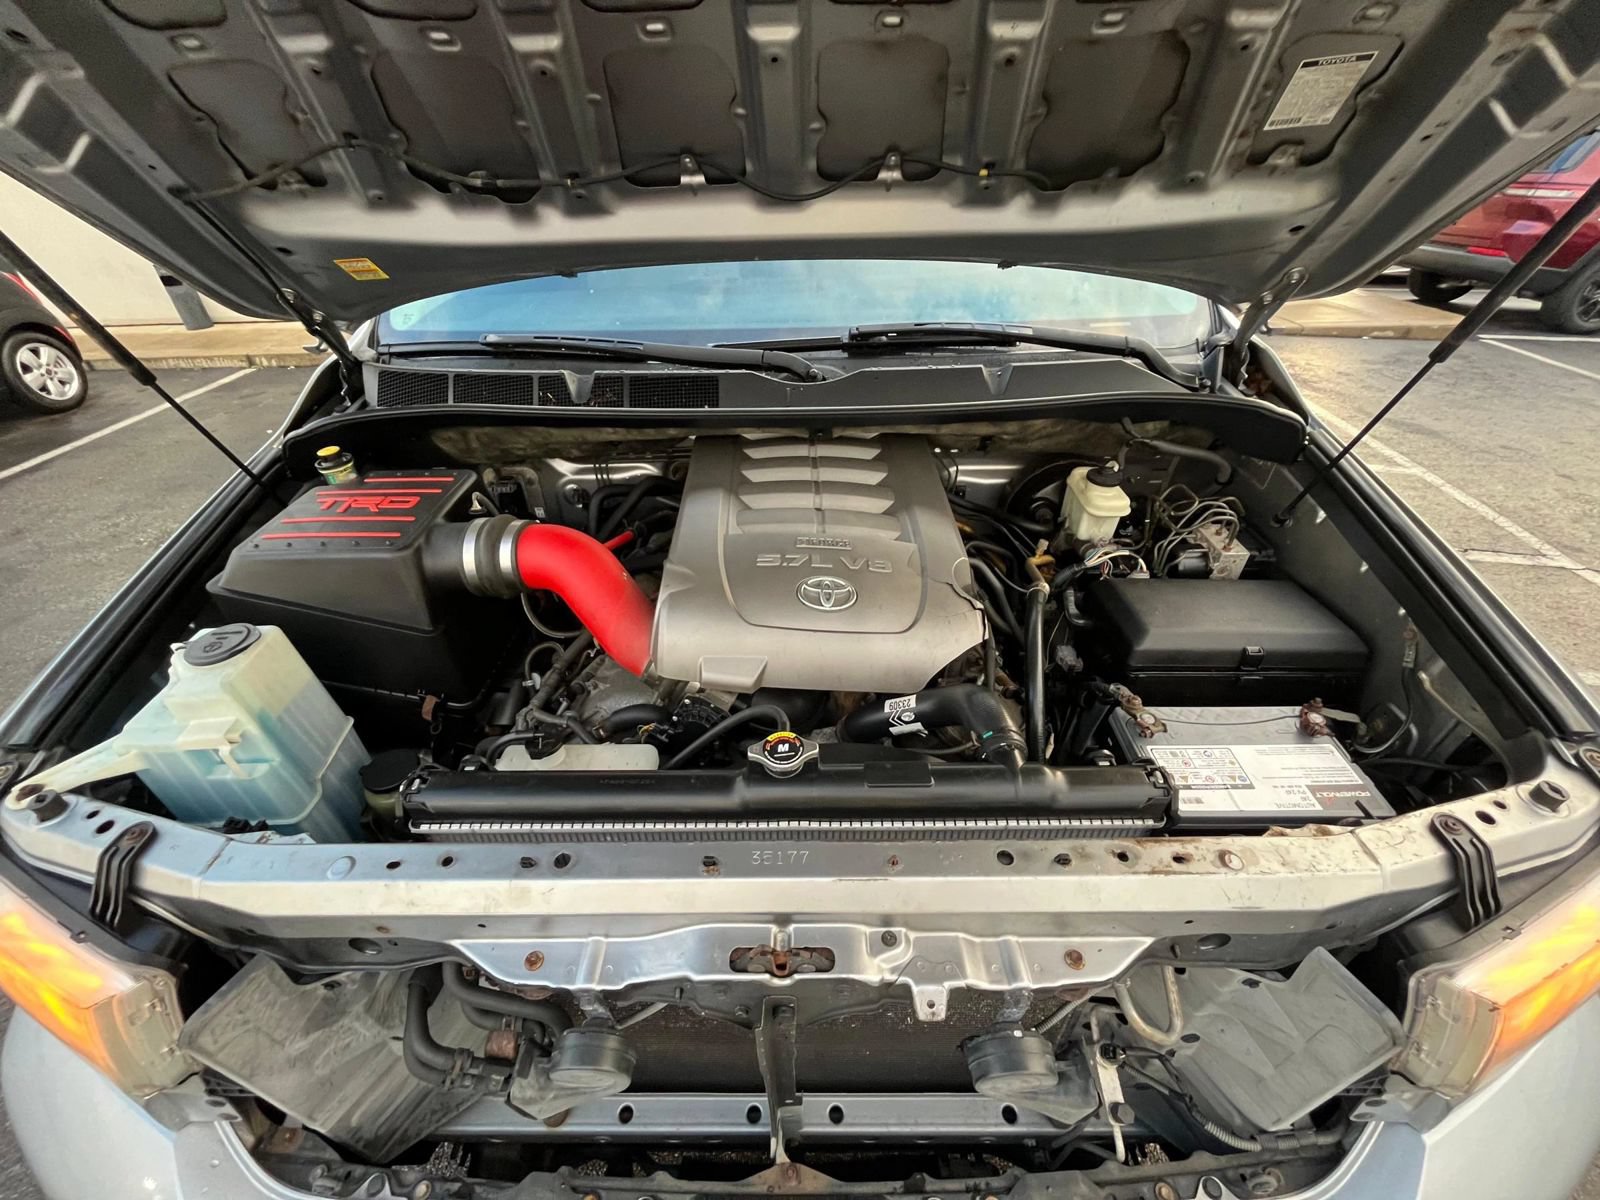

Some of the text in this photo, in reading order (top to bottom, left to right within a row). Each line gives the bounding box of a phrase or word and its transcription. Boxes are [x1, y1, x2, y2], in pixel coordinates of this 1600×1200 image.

[1318, 55, 1357, 66] TOYOTA
[316, 495, 421, 512] TRD
[756, 554, 893, 573] 5.7L V8
[888, 699, 911, 711] 23309
[1315, 790, 1372, 798] POWERVOLT
